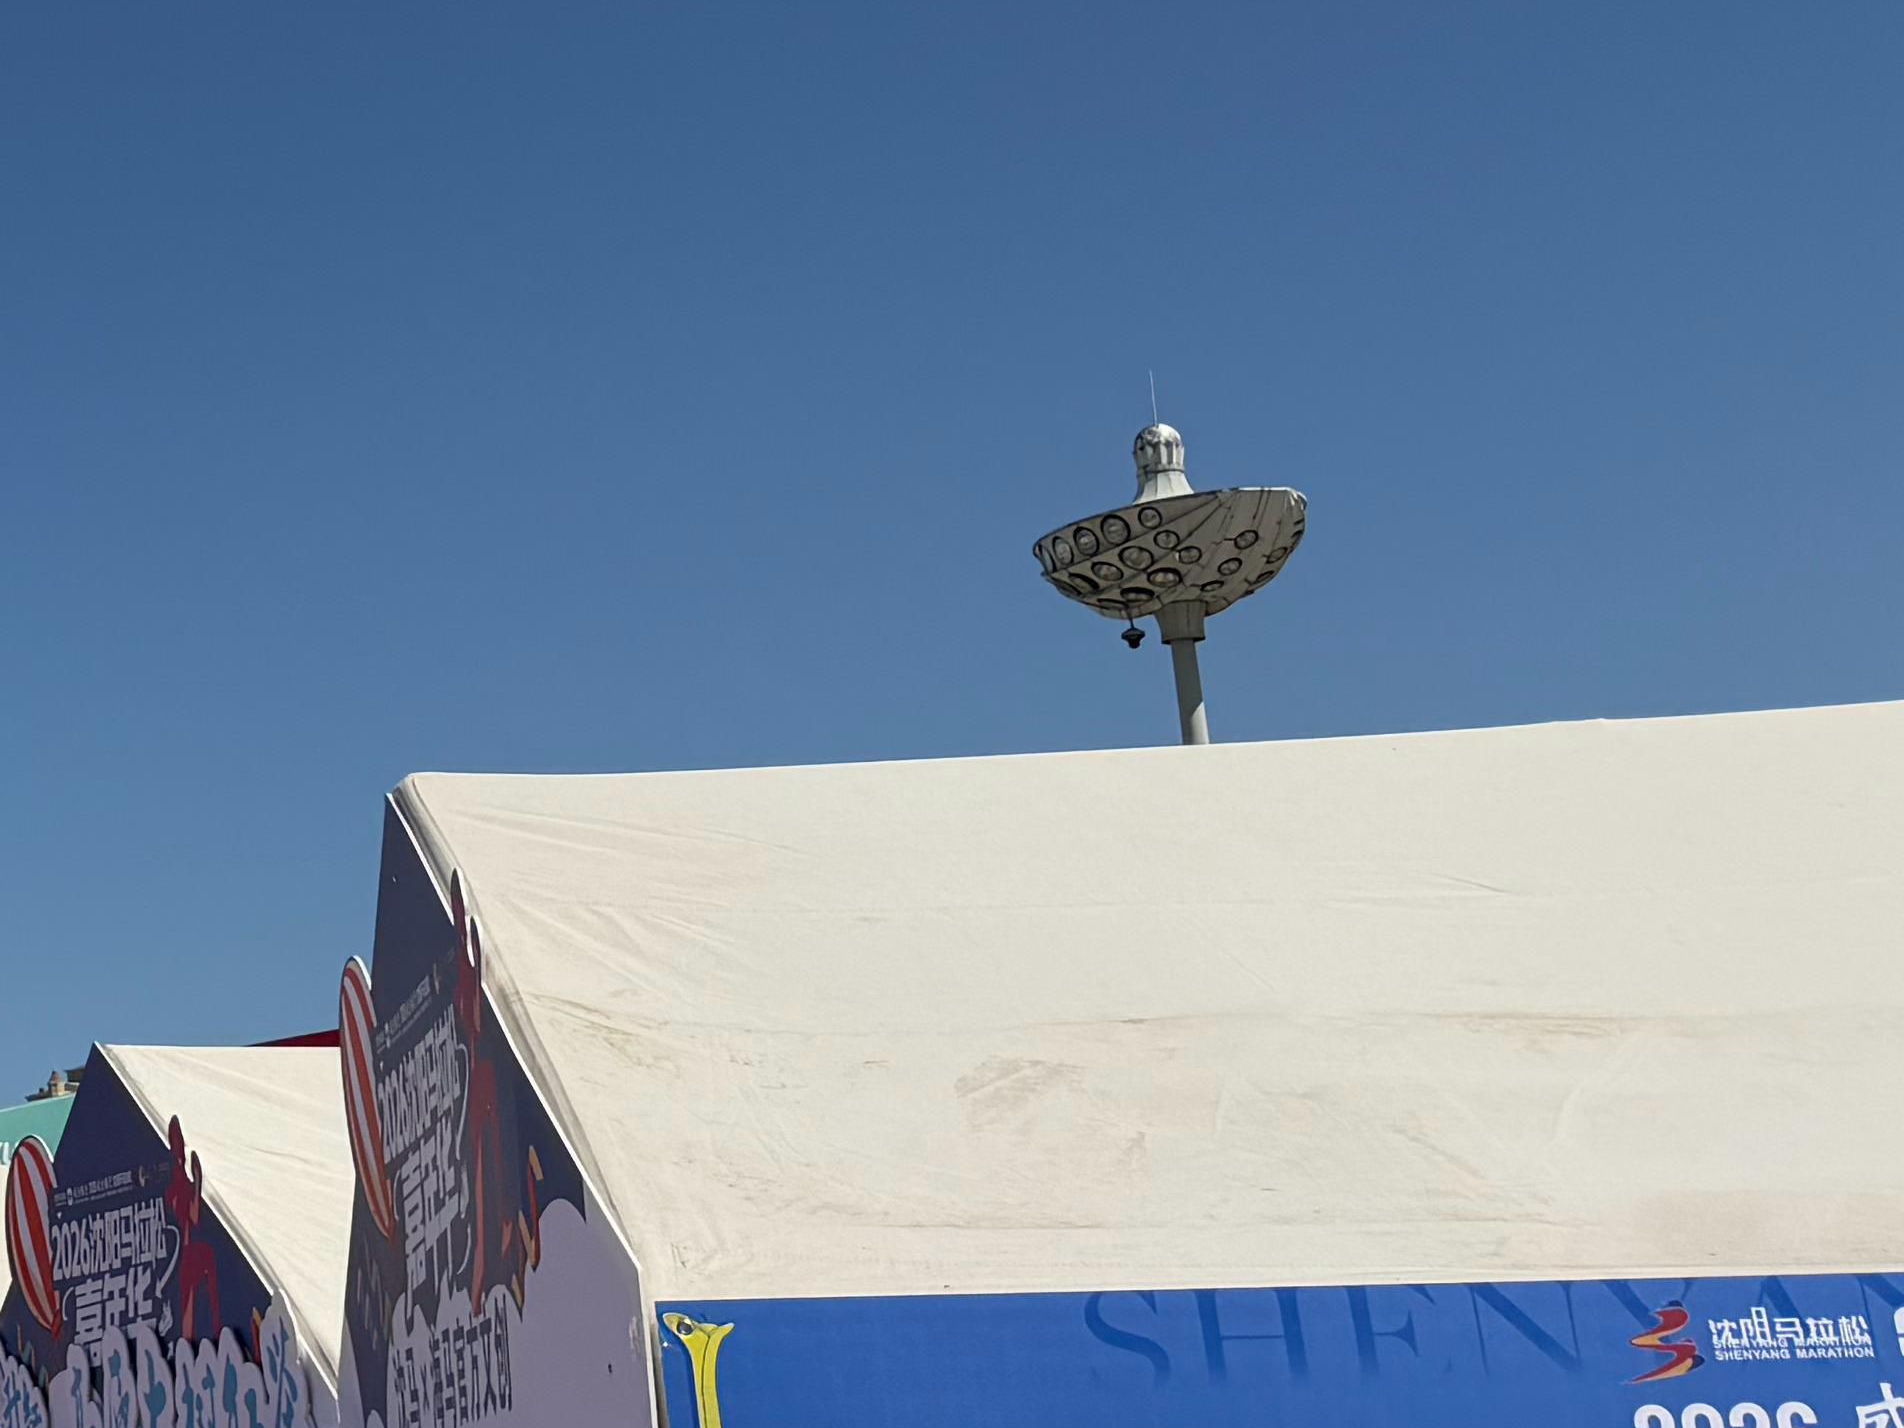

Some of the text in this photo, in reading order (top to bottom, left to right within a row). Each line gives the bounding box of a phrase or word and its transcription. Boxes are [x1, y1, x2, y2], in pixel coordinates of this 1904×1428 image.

[51, 1196, 167, 1281] 2026沈阳马拉松
[1708, 1307, 1869, 1343] 沈阳马拉松
[1715, 1347, 1875, 1361] SHENYANG MARATHON
